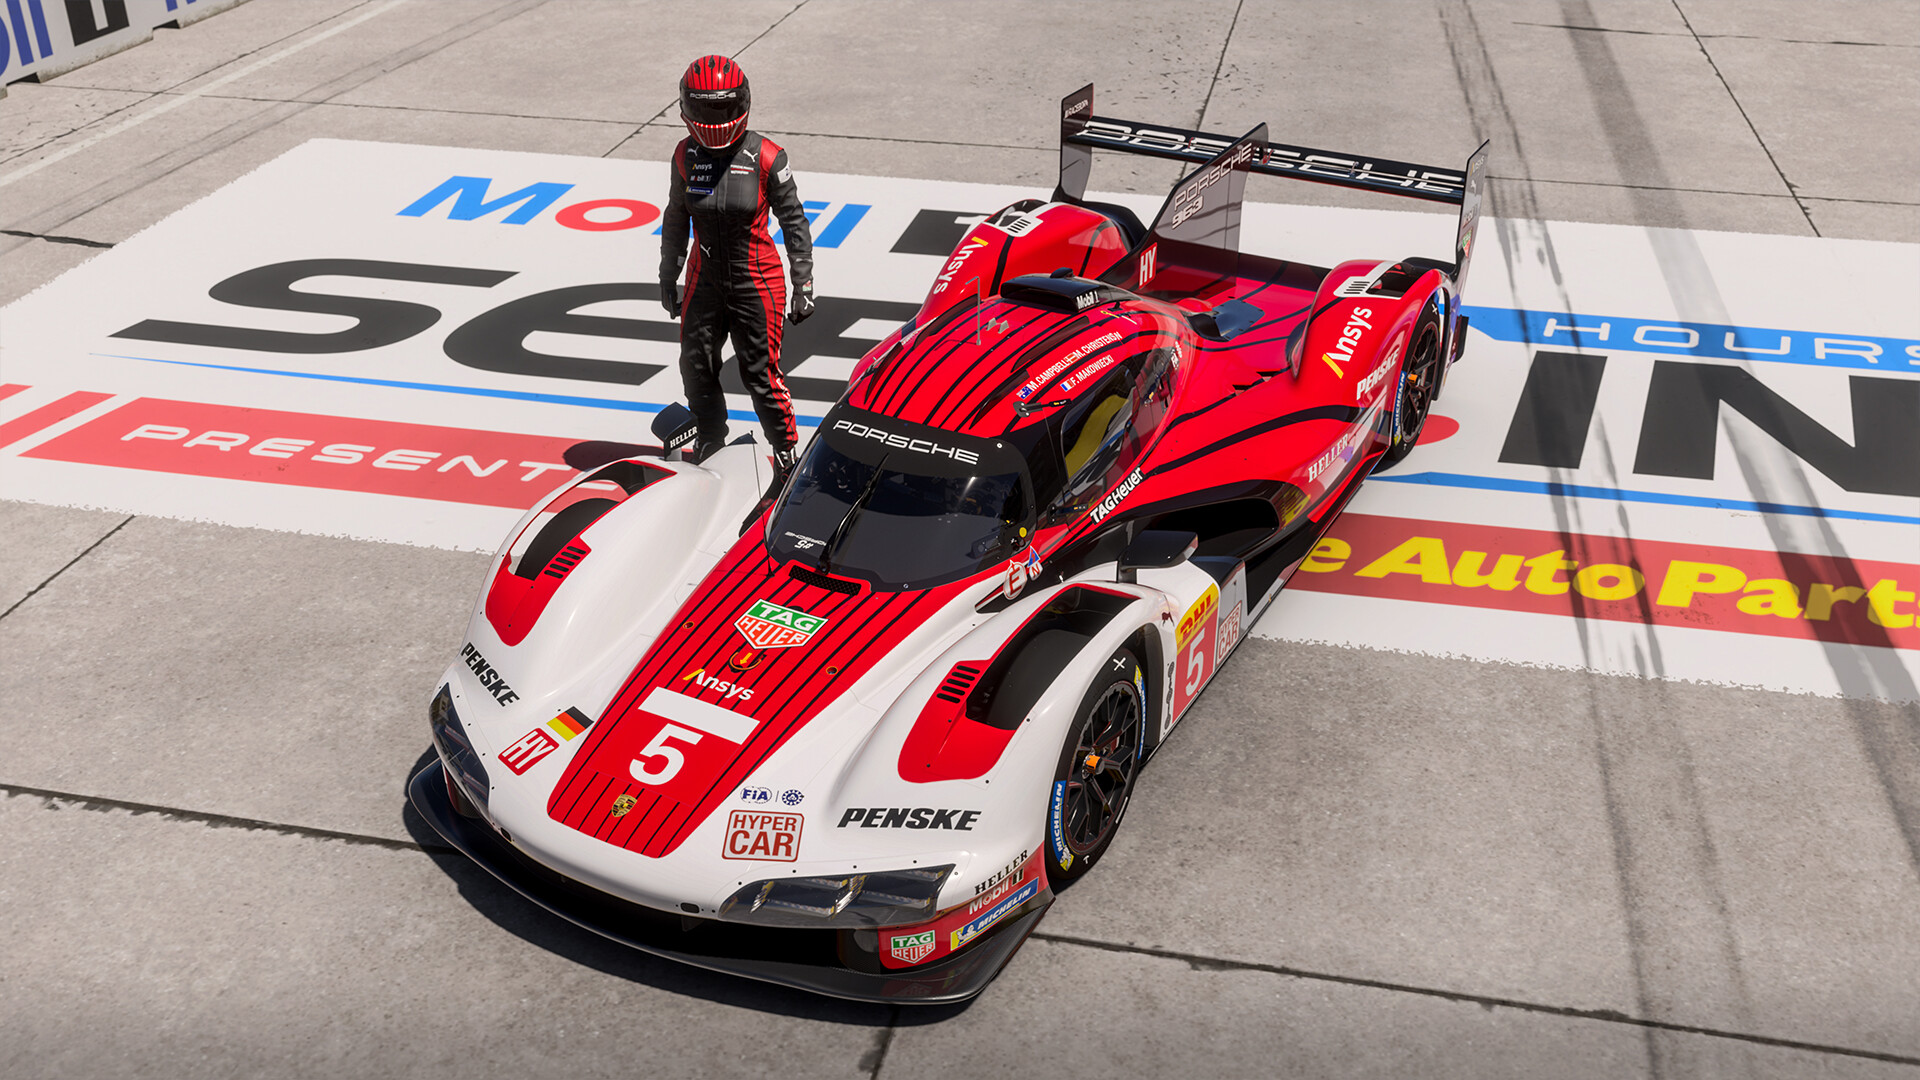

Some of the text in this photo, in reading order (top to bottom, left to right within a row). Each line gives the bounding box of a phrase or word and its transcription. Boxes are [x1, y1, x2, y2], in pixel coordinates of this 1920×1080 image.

[1173, 142, 1253, 211] PORSCHE
[394, 175, 872, 250] Moil
[1171, 195, 1204, 229] 963
[933, 236, 989, 295] Ansys
[1140, 246, 1157, 286] HY
[1077, 292, 1094, 310] Mobil
[1322, 306, 1373, 379] Ansys
[1542, 318, 1920, 365] HOUR
[1356, 345, 1400, 401] PENSKE
[121, 423, 618, 492] PRESENT
[669, 426, 698, 449] HELLER
[832, 420, 980, 465] PORSCHE
[1308, 433, 1350, 483] HELLER
[1009, 567, 1023, 596] E
[1353, 536, 1646, 601] Auto
[1656, 560, 1920, 630] Part
[738, 615, 812, 647] HEUER
[756, 604, 818, 631] TAG
[1180, 593, 1211, 634] DHL
[460, 642, 520, 708] PENSKE
[682, 668, 755, 702] Ansys
[1185, 627, 1206, 698] 5
[500, 729, 556, 774] HY
[629, 722, 704, 786] 5
[733, 815, 798, 832] HYPER
[836, 807, 982, 831] PENSKE
[1053, 783, 1064, 852] MICHELIN
[729, 829, 795, 857] CAR
[974, 850, 1029, 896] HELLER
[968, 881, 1009, 915] Mobil
[978, 886, 1032, 931] MICHELIN
[894, 943, 936, 961] HEUER
[895, 934, 933, 948] TAG
